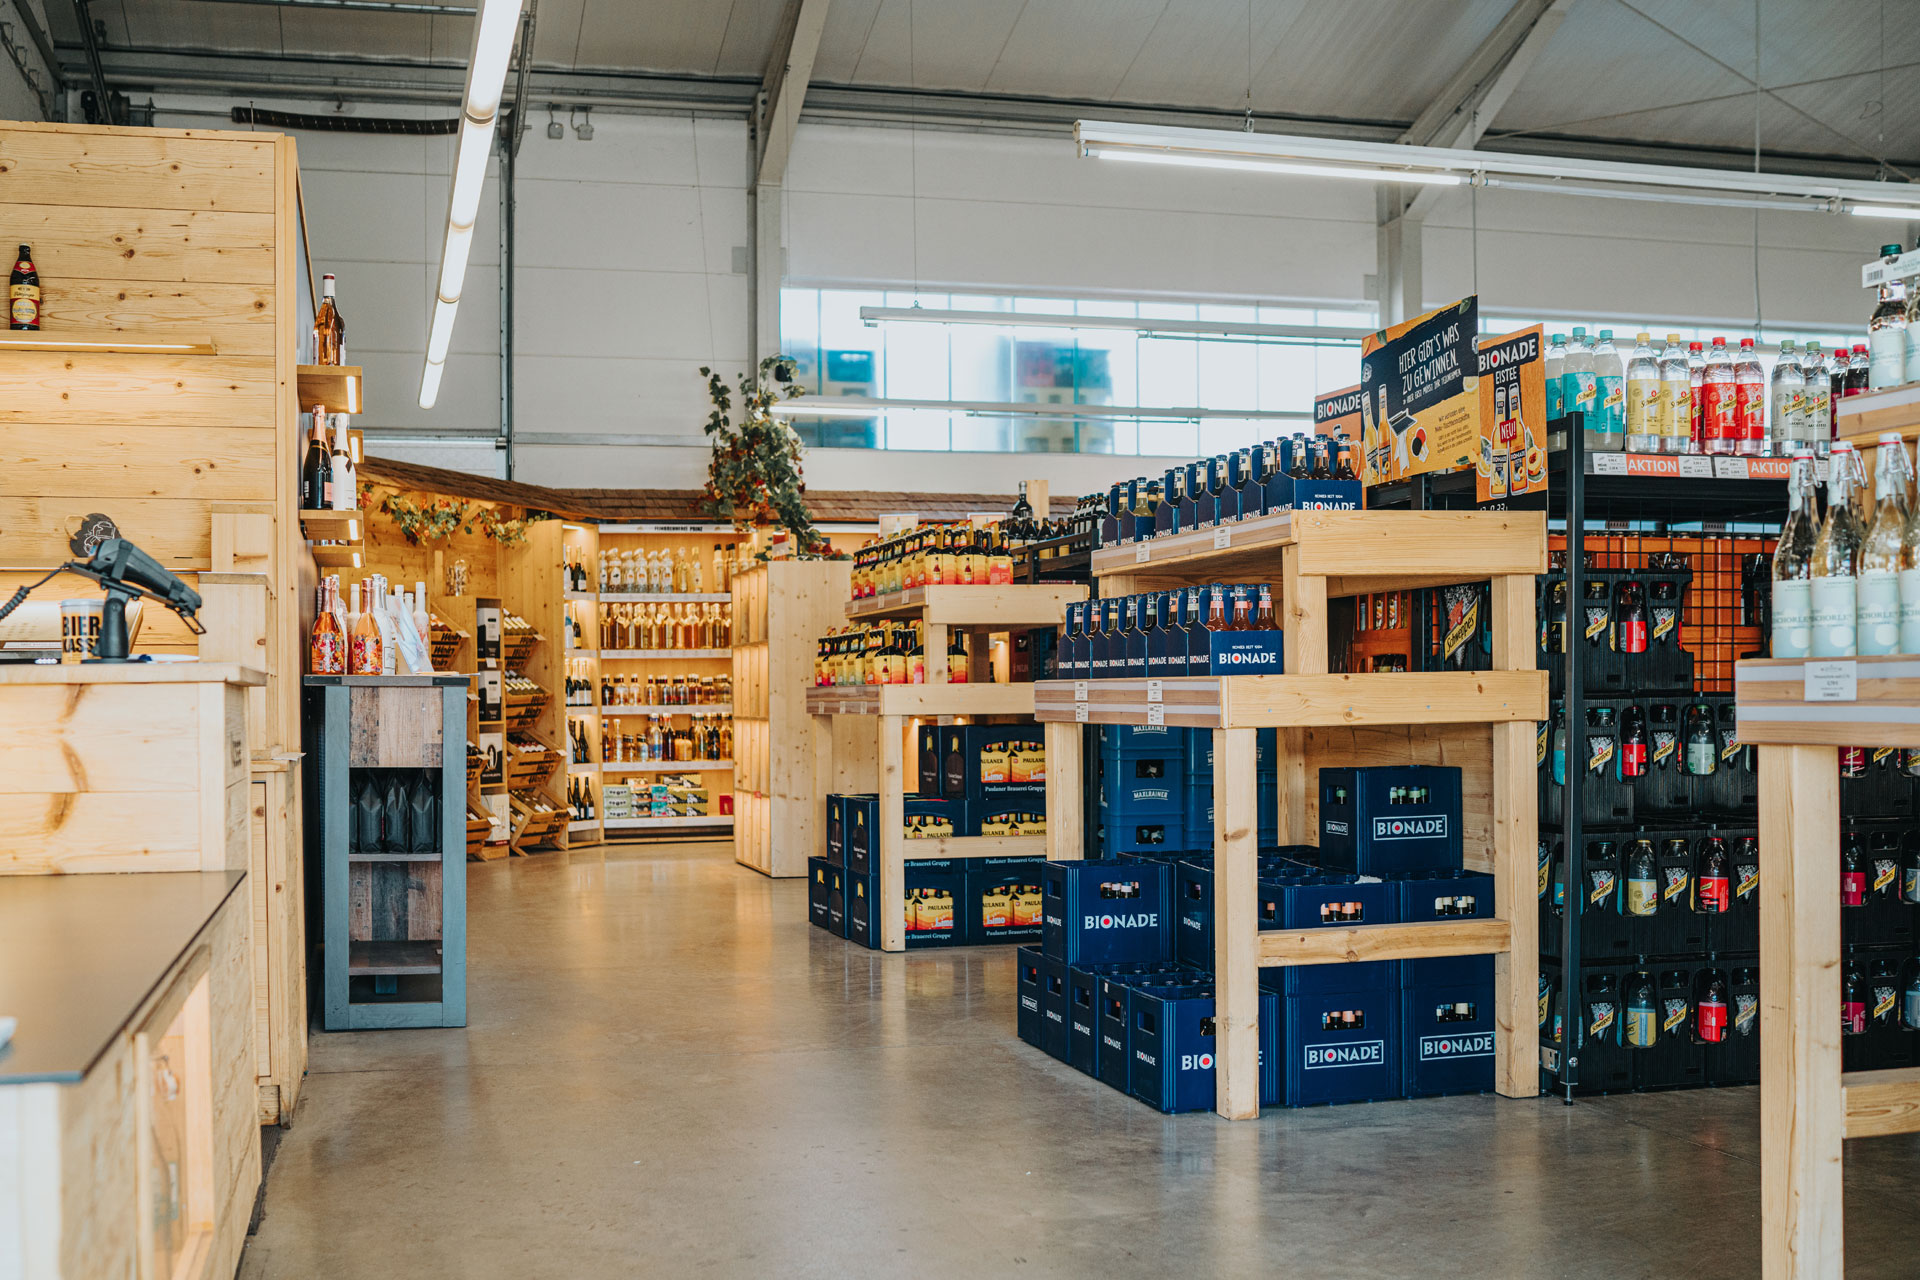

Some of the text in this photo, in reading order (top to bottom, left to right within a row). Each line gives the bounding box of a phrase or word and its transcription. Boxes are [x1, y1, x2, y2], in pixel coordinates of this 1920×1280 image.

[1399, 322, 1460, 375] HIER GIBT'S WAS
[1479, 338, 1537, 373] BIONADE
[1402, 348, 1460, 395] ZU GEWINNEN.
[1495, 366, 1518, 385] EISTEE
[1317, 393, 1362, 420] BIONADE
[1501, 420, 1516, 440] NEU!
[1628, 460, 1678, 474] AKTION
[1751, 461, 1792, 475] AKTIO
[1302, 501, 1356, 511] BIONADE
[62, 616, 100, 637] BIER
[1447, 614, 1475, 653] Schweppes
[1148, 656, 1167, 665] BIONADE
[1168, 655, 1186, 664] BIONADE
[1190, 655, 1209, 664] BIONADE
[1219, 652, 1277, 665] BIONADE
[1030, 770, 1046, 780] Lim
[1327, 823, 1347, 834] BIONADE
[1377, 820, 1443, 836] BIONADE
[1592, 883, 1612, 900] Schweppes
[1666, 880, 1686, 898] Schweppes
[1046, 915, 1062, 927] BIONADE
[1084, 913, 1158, 930] BIONADE
[1183, 916, 1202, 931] BIONADE
[1046, 1009, 1063, 1024] BIONADE
[1592, 1016, 1612, 1033] Schweppes
[1665, 1012, 1686, 1029] Schweppes
[1074, 1021, 1091, 1036] BIONADE
[1104, 1035, 1122, 1050] BIONADE
[1424, 1036, 1492, 1056] BIONADE
[1136, 1050, 1156, 1066] BIONADE
[1308, 1045, 1380, 1064] BIONADE
